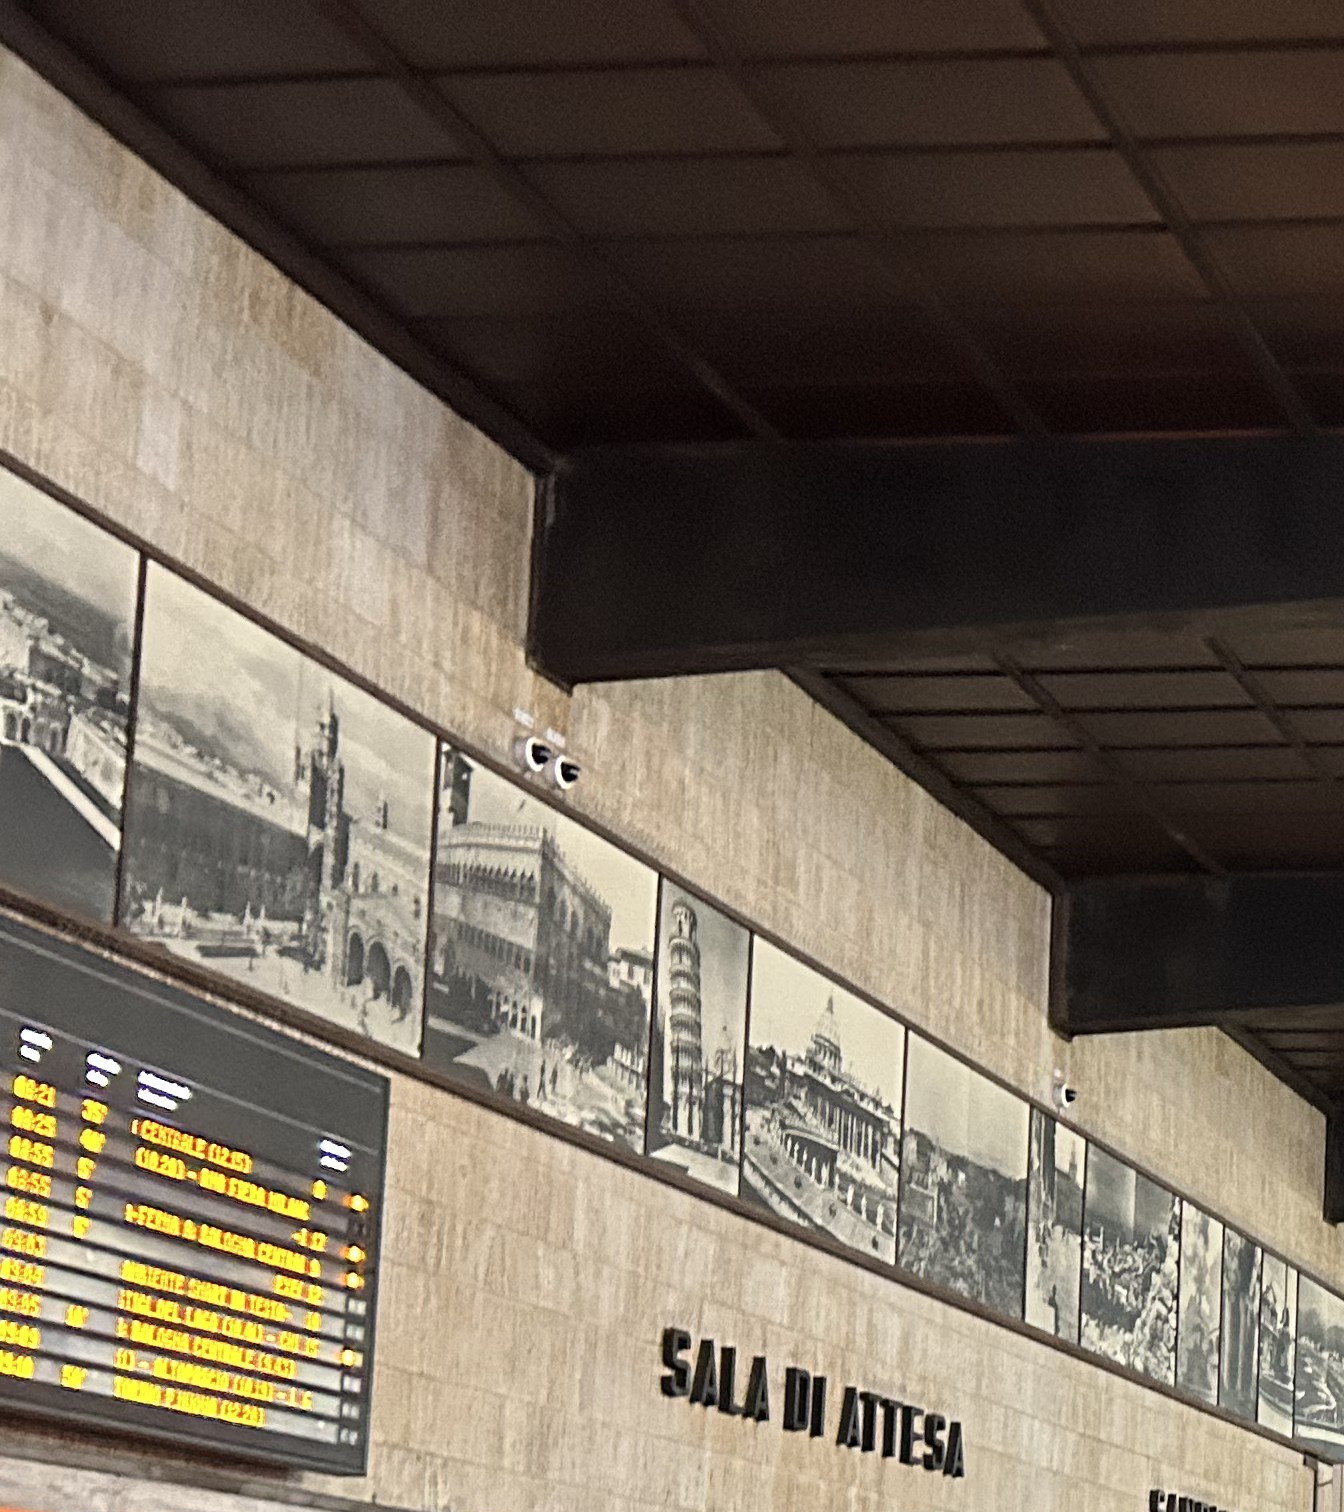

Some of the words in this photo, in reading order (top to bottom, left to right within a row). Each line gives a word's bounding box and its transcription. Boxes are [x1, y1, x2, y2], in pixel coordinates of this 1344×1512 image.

[661, 1327, 769, 1422] SALA
[783, 1367, 826, 1437] DI
[836, 1386, 965, 1478] ATTESA
